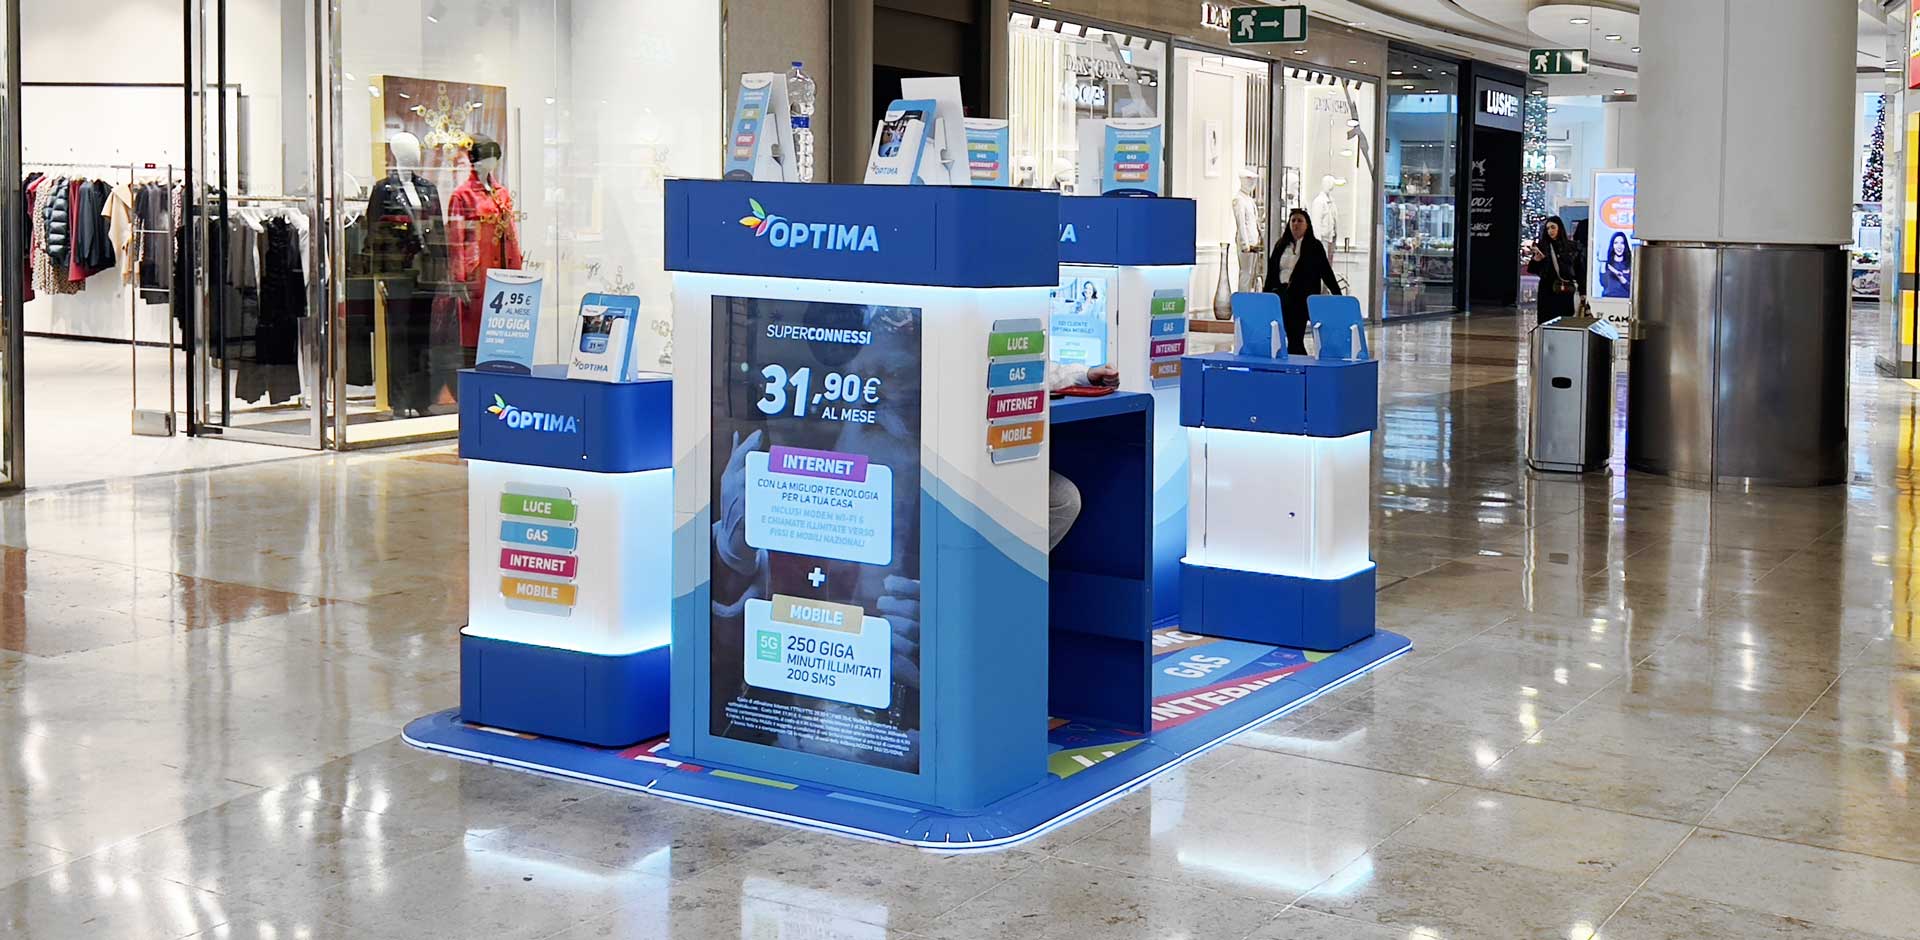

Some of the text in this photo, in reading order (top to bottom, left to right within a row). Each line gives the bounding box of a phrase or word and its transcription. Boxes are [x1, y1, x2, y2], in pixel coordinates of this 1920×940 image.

[1486, 89, 1511, 117] LUSH
[769, 222, 879, 252] OPTIMA
[1161, 301, 1176, 311] LUCE
[487, 317, 530, 330] 100 GIGA
[1162, 322, 1174, 332] GAS
[766, 324, 873, 345] SUPERCONNESSI
[1007, 337, 1029, 351] LUCE
[1155, 342, 1182, 354] INTERNET
[578, 363, 608, 373] OPTIMA
[1009, 367, 1026, 381] GAS
[996, 396, 1039, 413] INTERNET
[507, 410, 577, 433] OPTIMA
[822, 406, 877, 424] AL MESE
[1001, 426, 1033, 443] MOBILE
[783, 454, 854, 475] INTERNET
[758, 478, 879, 501] CON LA MIGLIOR TECNOLOGIA
[522, 499, 553, 515] LUCE
[782, 492, 853, 509] PER LA TUA CASA
[771, 505, 802, 517] INCLUSI
[526, 528, 549, 542] GAS
[767, 516, 806, 528] CHIAMATE
[806, 520, 847, 534] ILLIMITATE
[848, 524, 875, 537] VERSO
[509, 553, 567, 572] INTERNET
[516, 582, 559, 599] MOBILE
[790, 604, 845, 625] MOBILE
[760, 635, 779, 650] 5G
[787, 635, 855, 660] 250 GIGA
[787, 653, 827, 671] MINUTI
[827, 659, 882, 679] ILLIMITATI
[1163, 654, 1232, 679] GAS
[787, 668, 837, 687] 200 SMS
